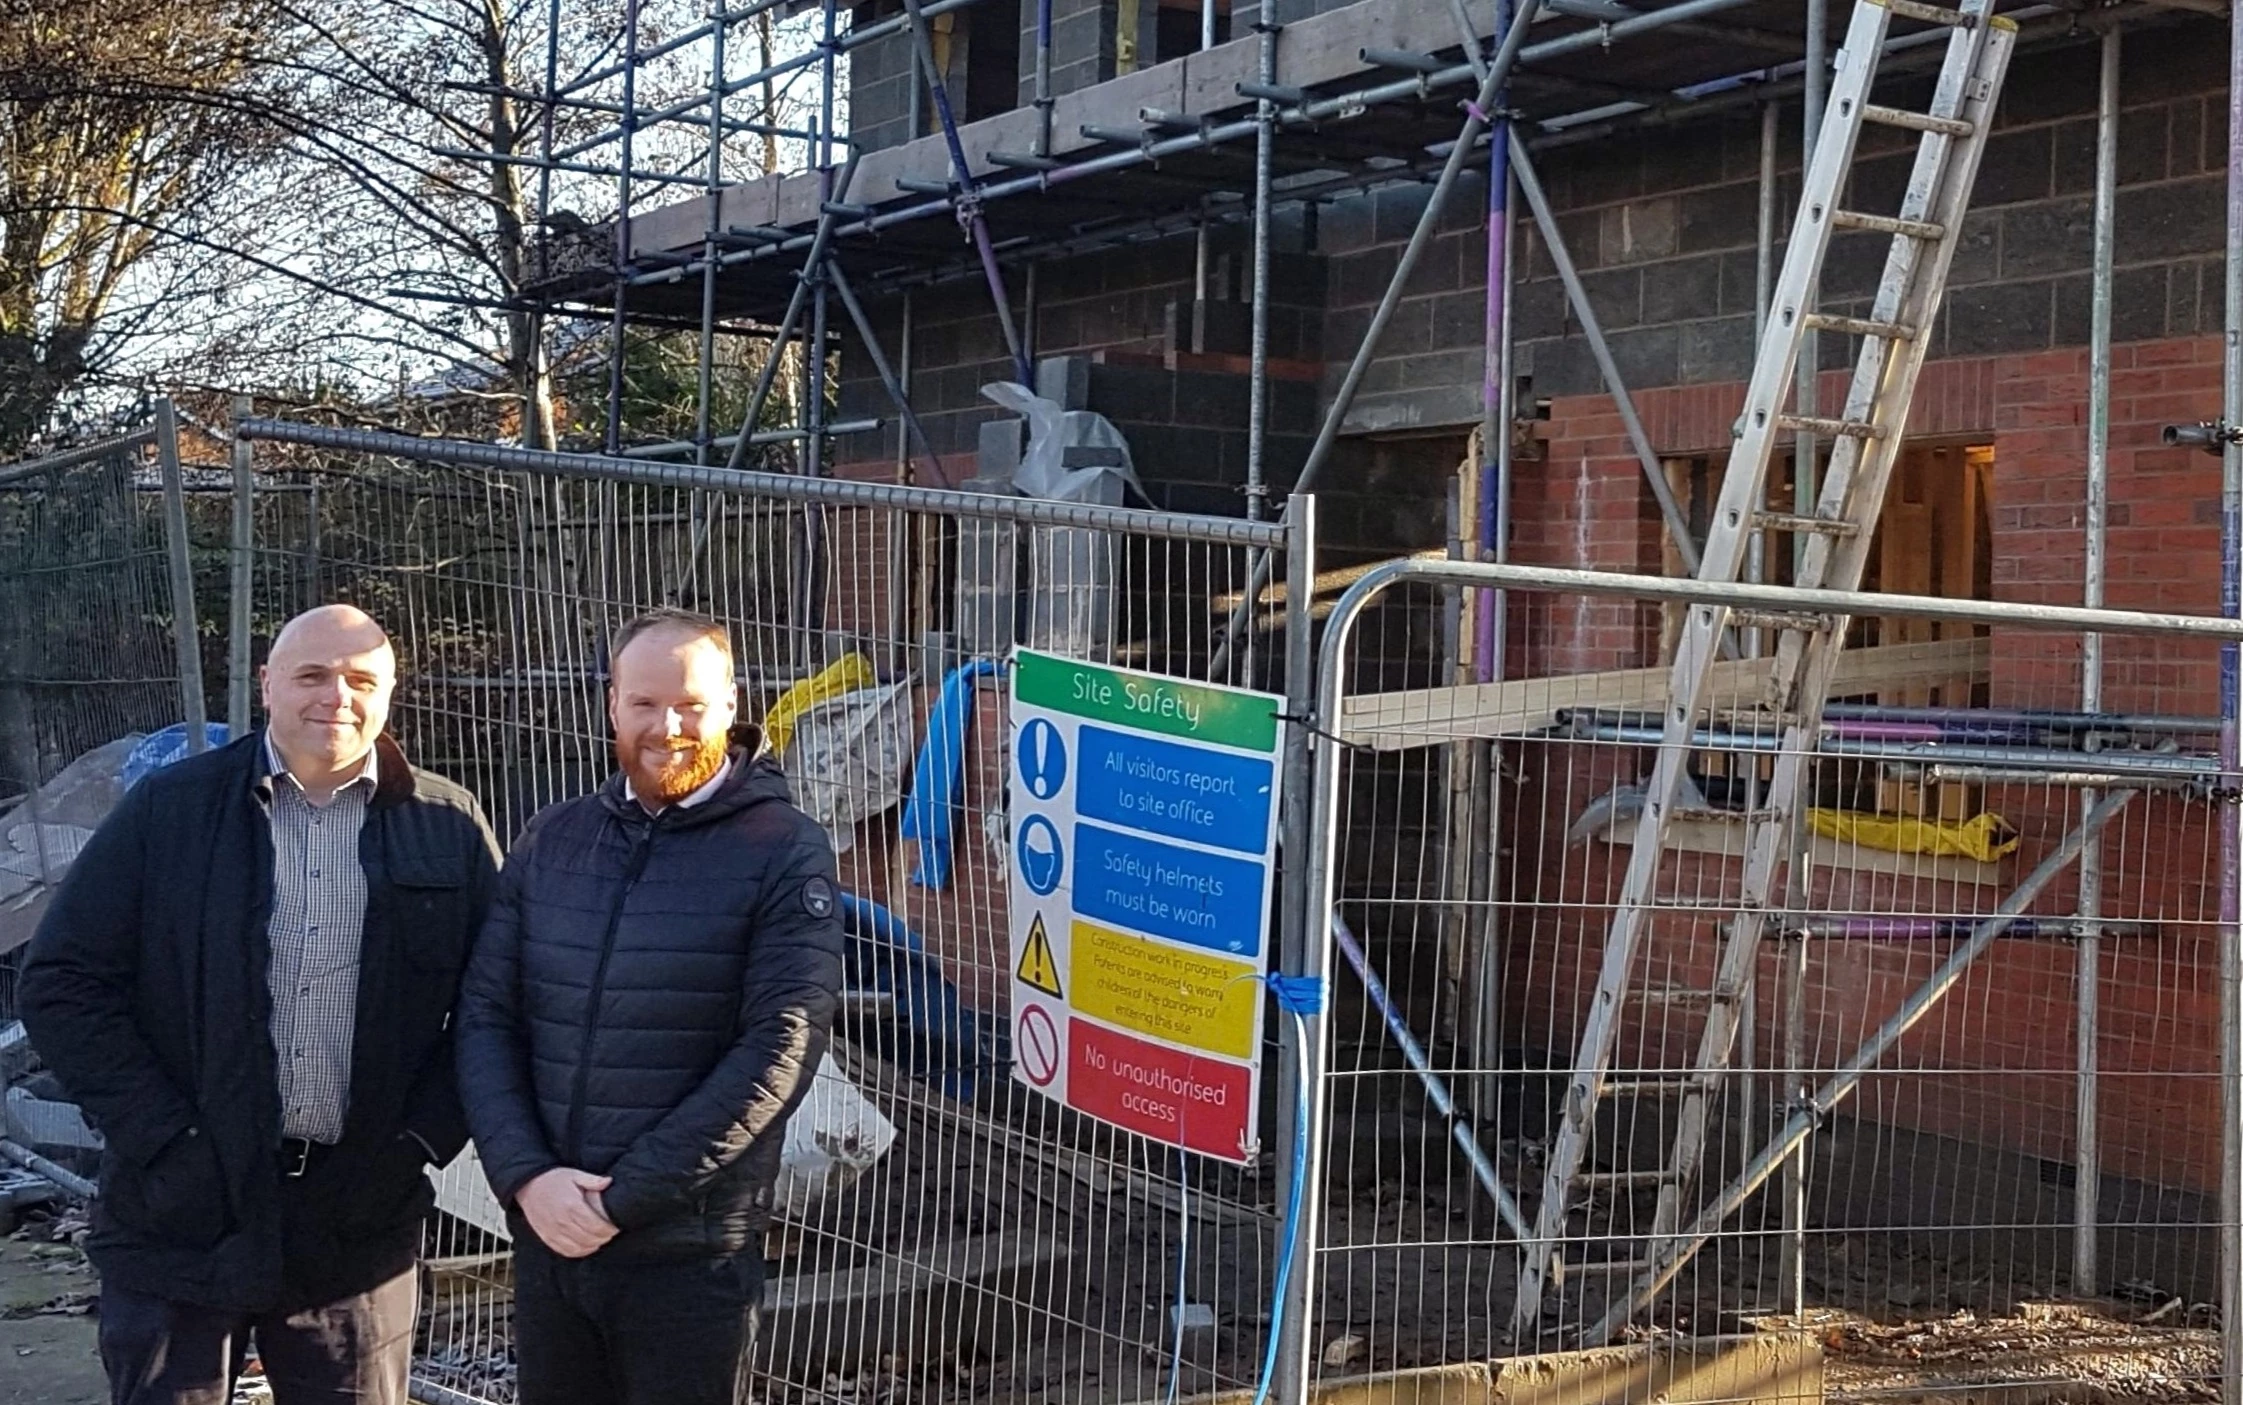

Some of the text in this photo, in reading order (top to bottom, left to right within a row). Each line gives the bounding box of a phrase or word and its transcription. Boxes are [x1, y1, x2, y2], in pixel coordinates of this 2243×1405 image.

[1073, 672, 1200, 731] Site Safety
[1104, 751, 1236, 797] All visitors report
[1119, 788, 1215, 826] to site office
[1104, 849, 1224, 897] Safety helmets
[1105, 888, 1217, 930] must be worn
[1091, 931, 1146, 959] Construction
[1148, 952, 1171, 967] work
[1173, 952, 1183, 969] in
[1097, 976, 1131, 996] children
[1144, 988, 1161, 1006] the
[1162, 996, 1203, 1019] dangers
[1205, 1005, 1217, 1020] of
[1127, 966, 1143, 979] are
[1144, 969, 1181, 990] advised
[1115, 1004, 1192, 1035] entering this site
[1085, 1043, 1227, 1107] No unauthorised
[1122, 1091, 1176, 1123] access
